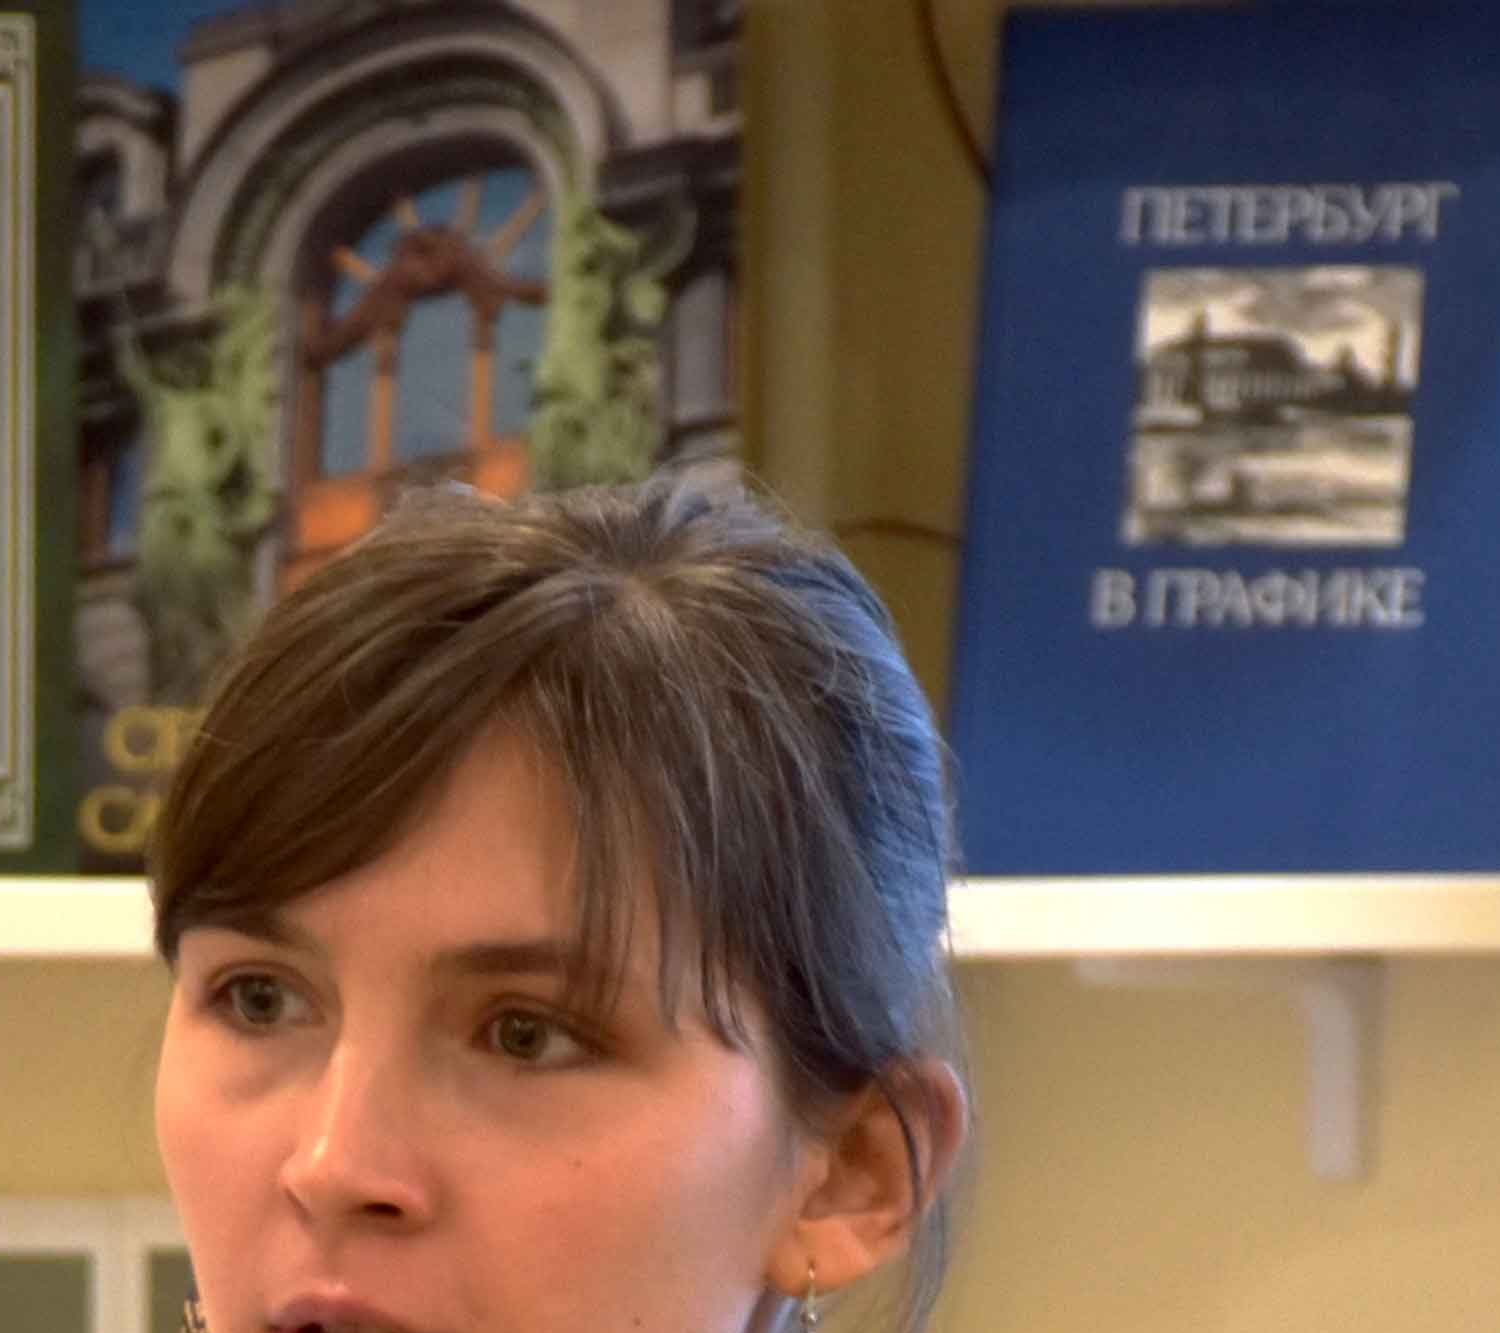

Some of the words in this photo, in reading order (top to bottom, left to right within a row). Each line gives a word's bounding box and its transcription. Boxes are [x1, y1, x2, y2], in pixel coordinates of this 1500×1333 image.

[1120, 183, 1460, 247] ПЕТЕРБУРГ
[1091, 571, 1136, 626] В
[1148, 569, 1426, 628] ГРАФИКЕ
